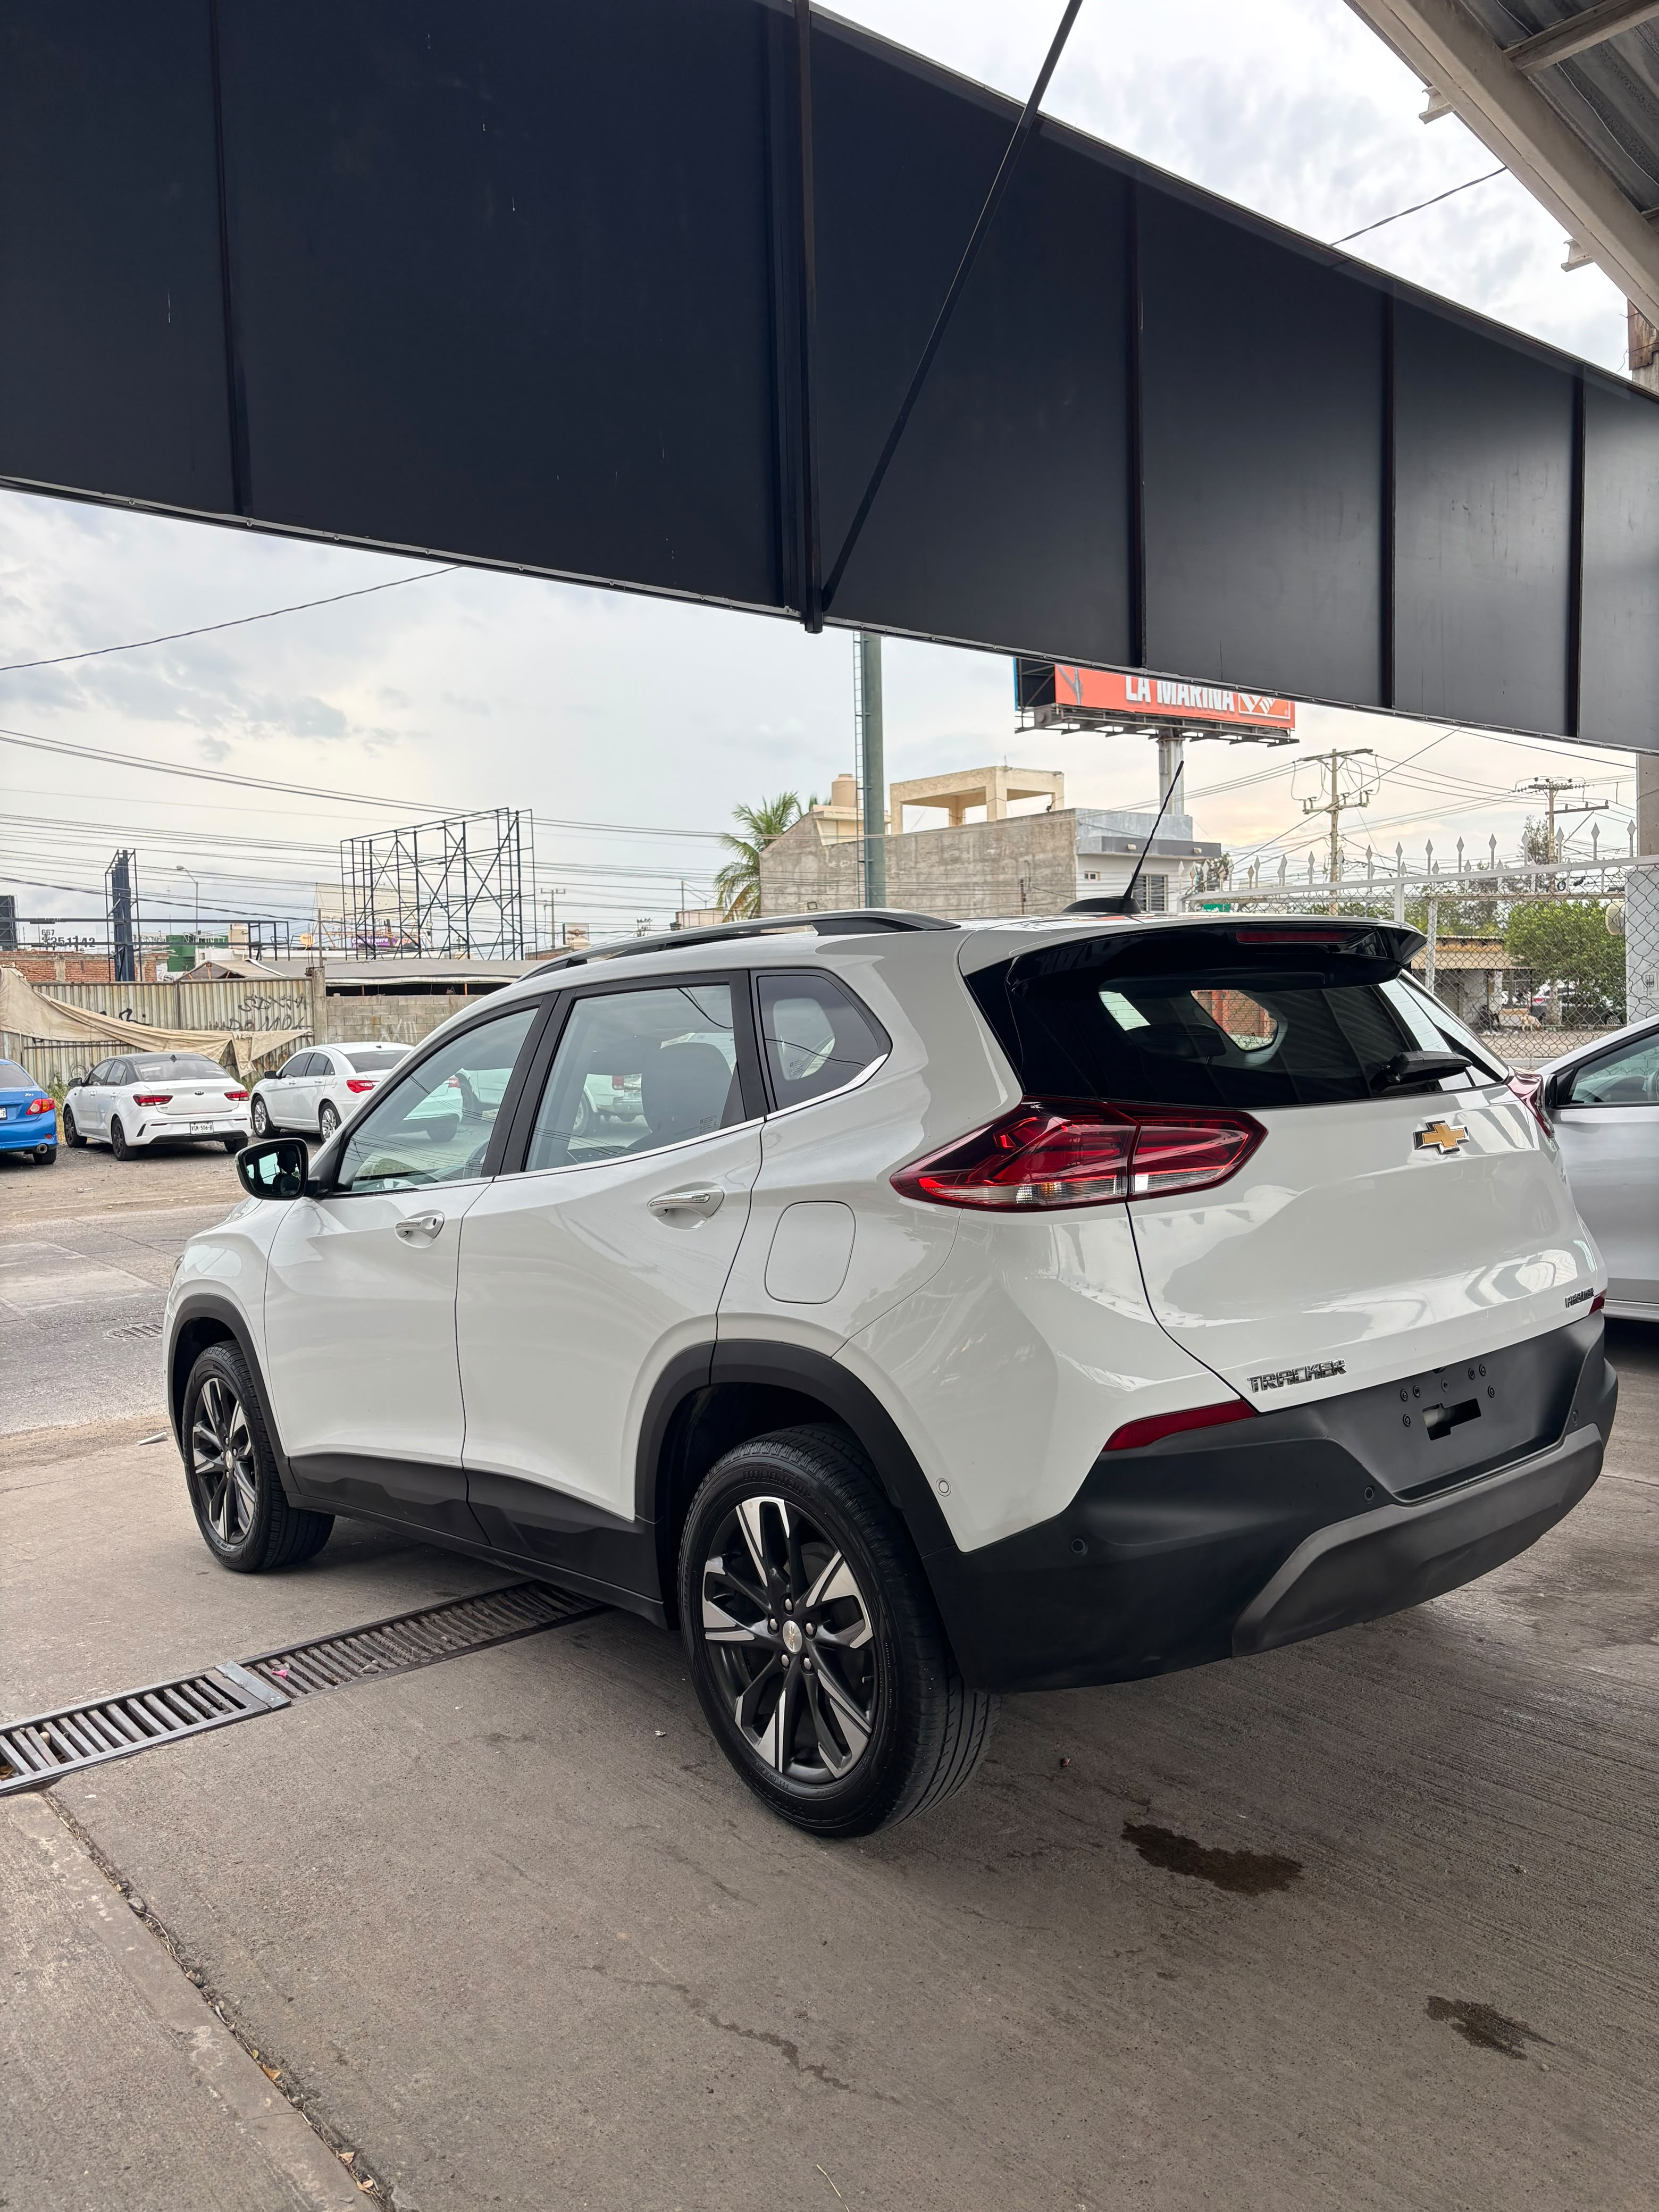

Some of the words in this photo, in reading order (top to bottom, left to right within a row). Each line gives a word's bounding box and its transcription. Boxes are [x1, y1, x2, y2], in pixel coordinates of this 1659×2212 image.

[1125, 676, 1151, 703] LA
[1157, 681, 1235, 713] MARINA
[1565, 1287, 1594, 1308] PREMIER
[1247, 1359, 1346, 1393] TRACKER
